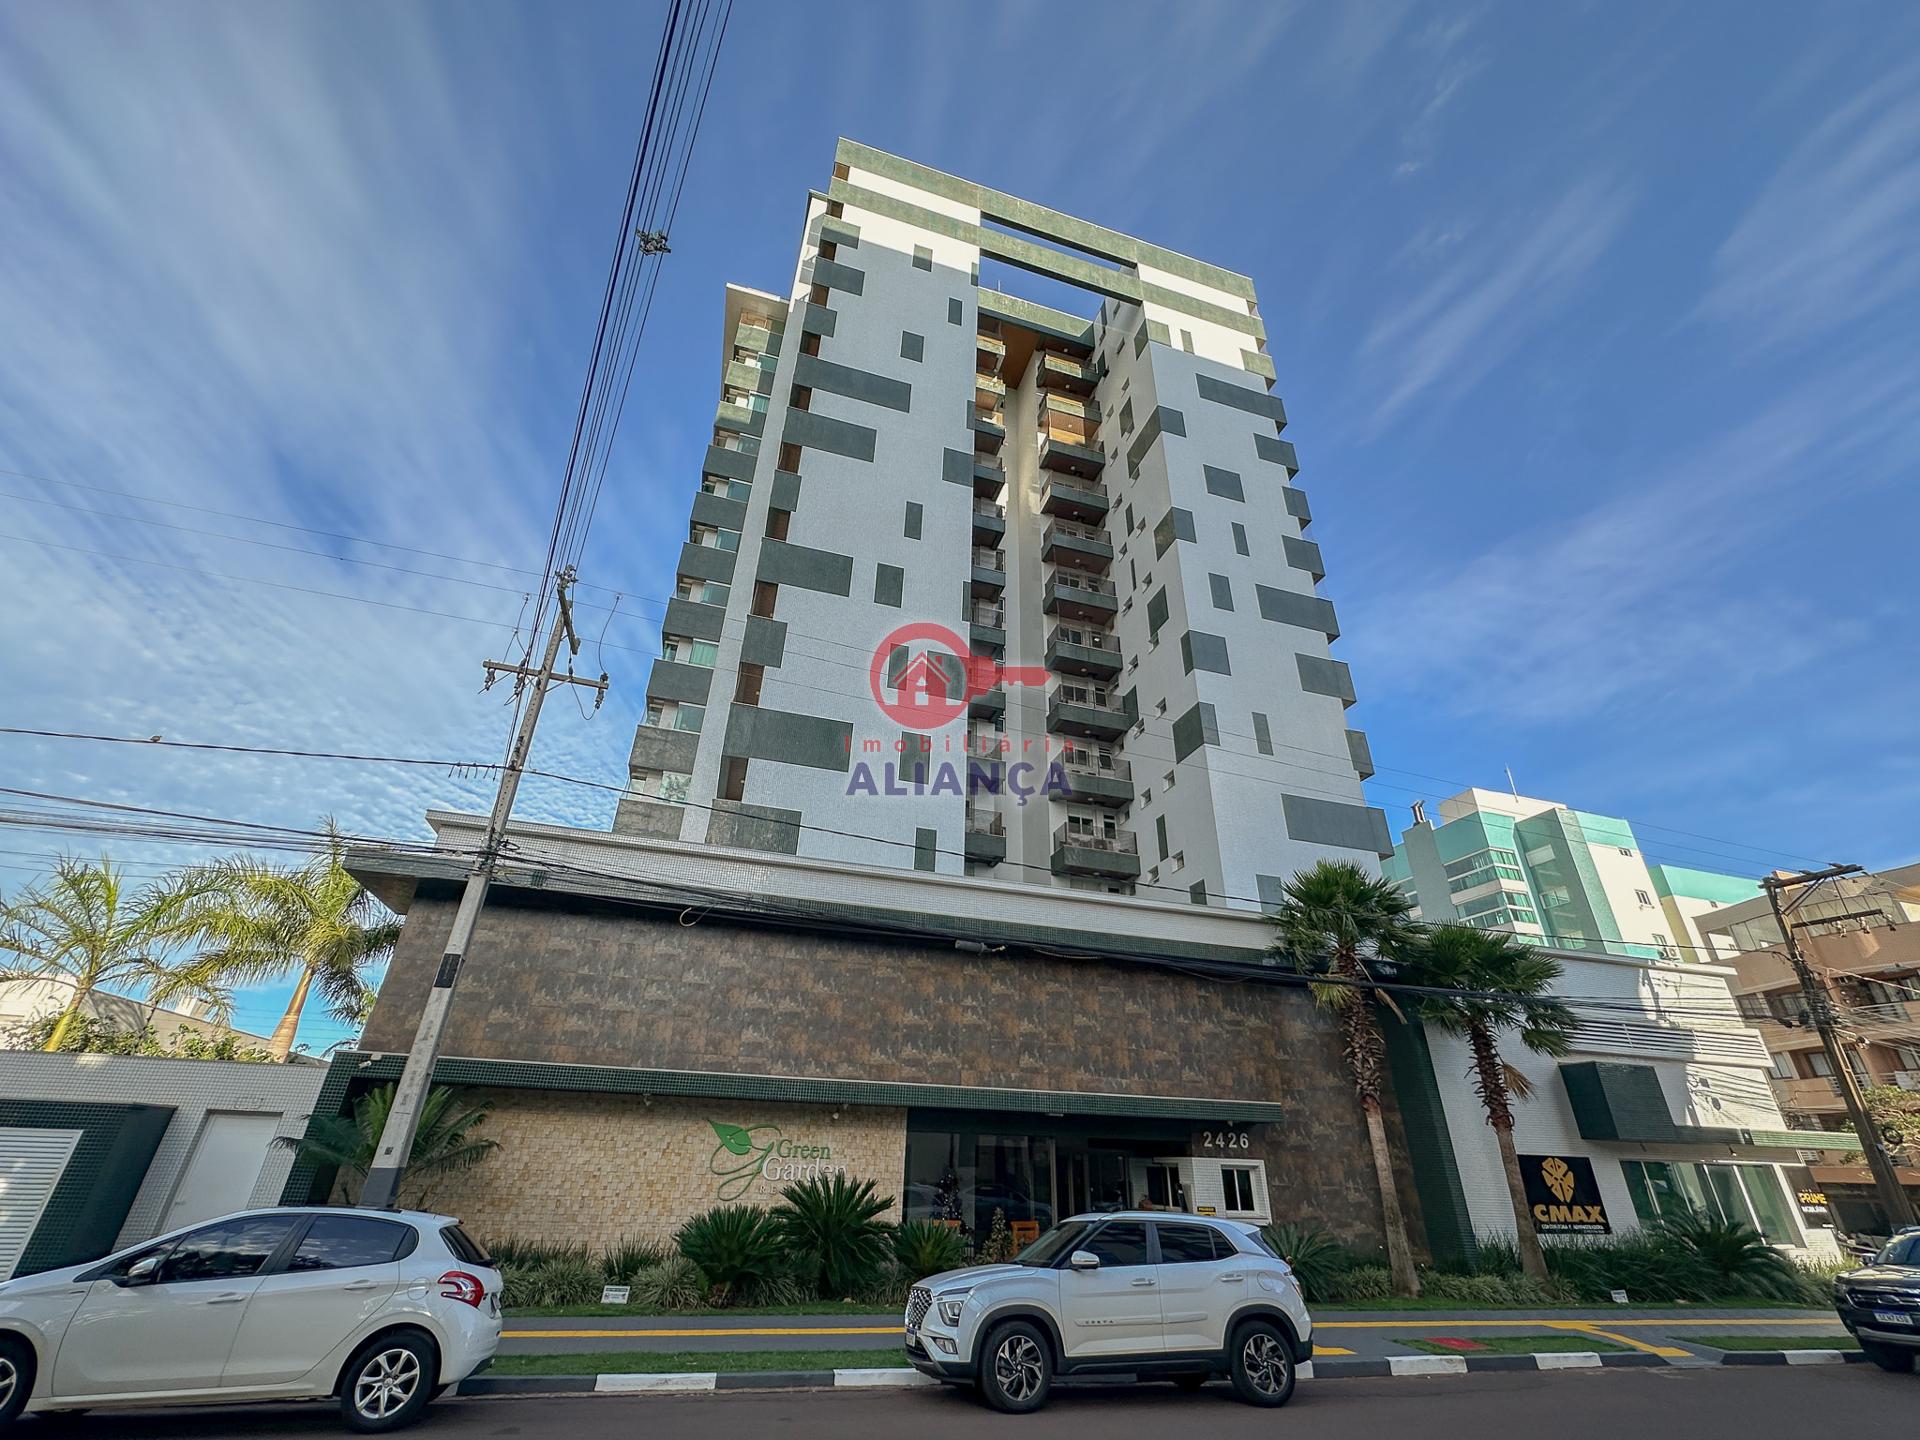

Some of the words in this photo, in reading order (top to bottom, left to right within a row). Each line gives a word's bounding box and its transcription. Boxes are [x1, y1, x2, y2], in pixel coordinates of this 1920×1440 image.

[776, 1138, 832, 1160] Green
[1203, 1131, 1249, 1149] 2426
[1533, 1203, 1607, 1223] CMAX
